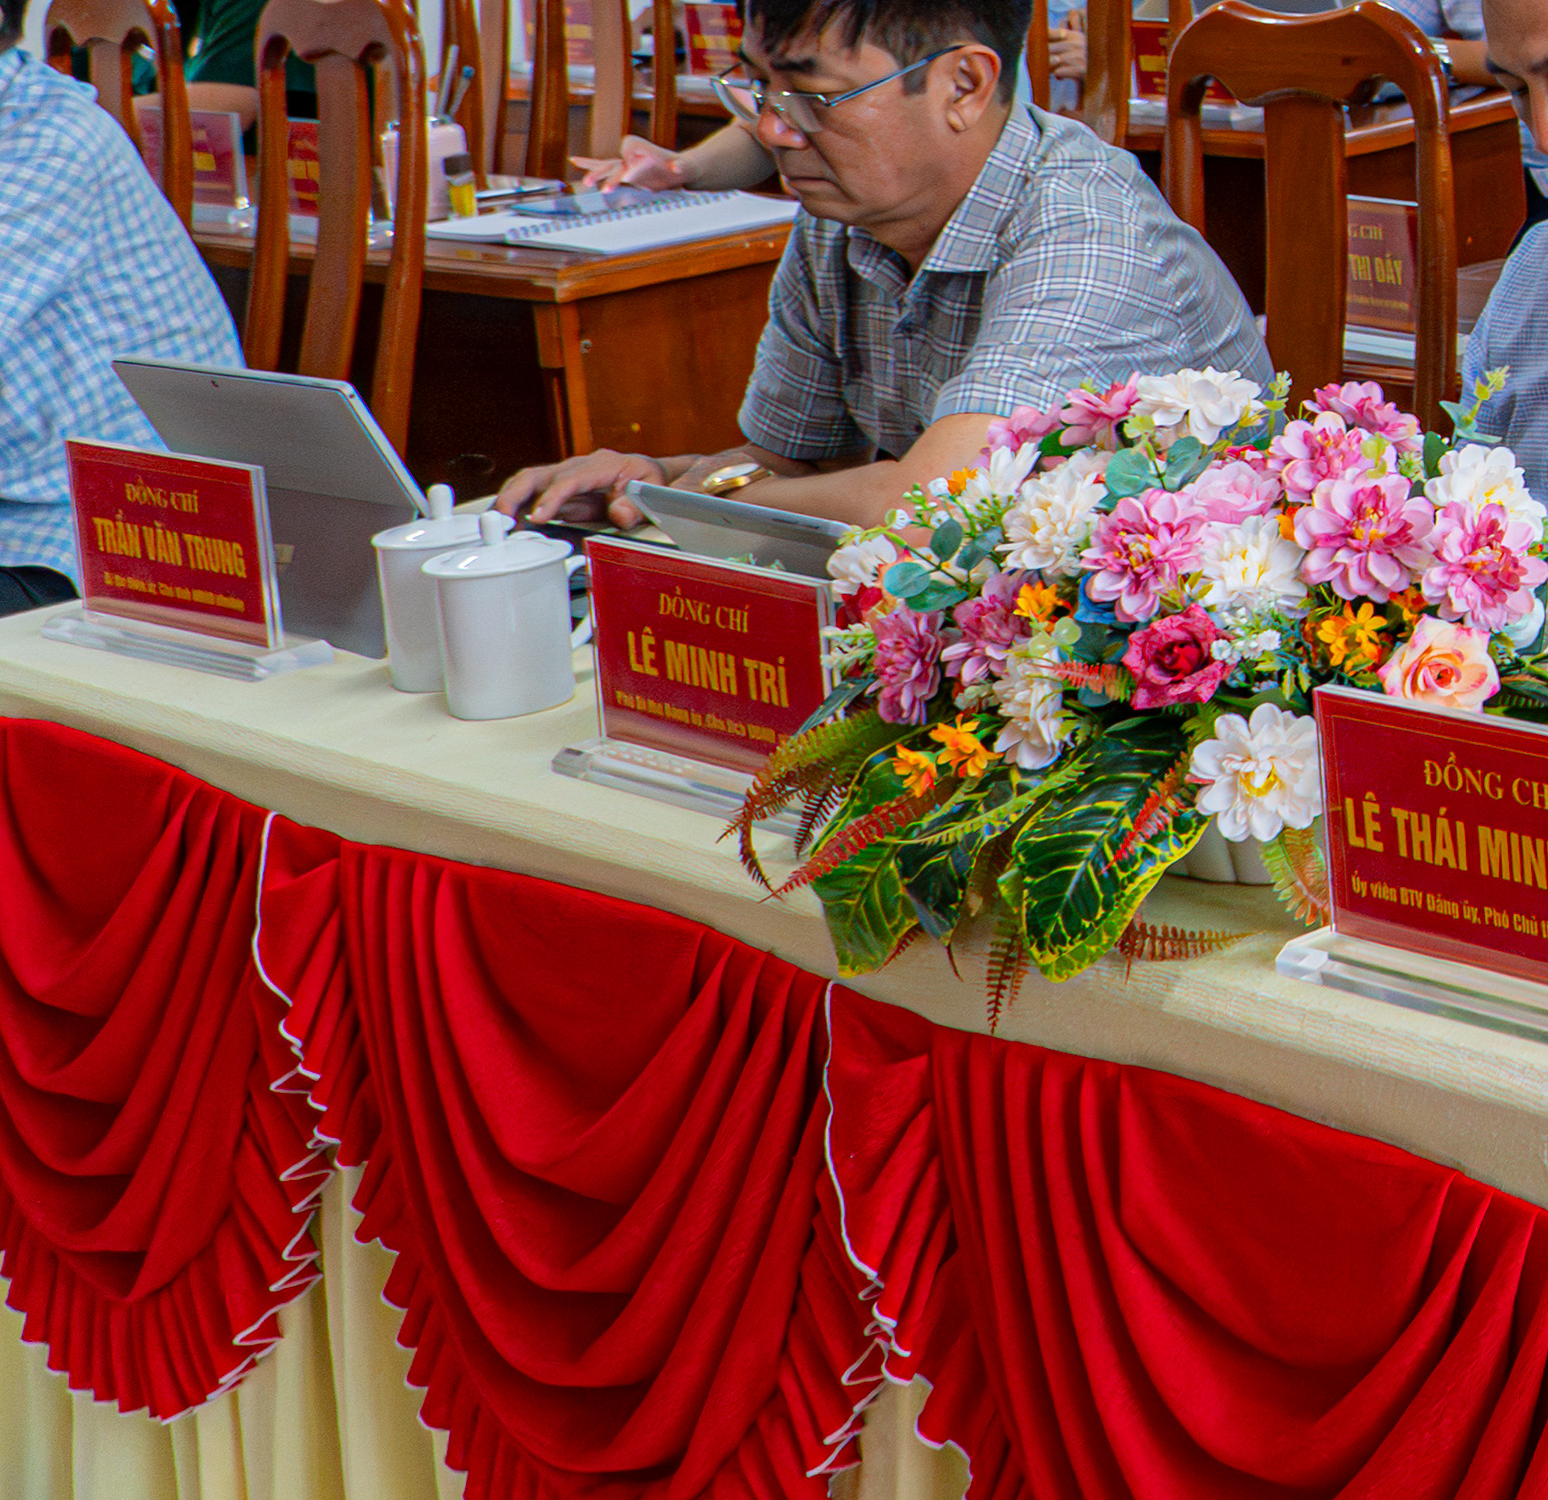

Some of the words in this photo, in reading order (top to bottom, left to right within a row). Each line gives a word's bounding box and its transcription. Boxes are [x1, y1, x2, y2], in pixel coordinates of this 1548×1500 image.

[93, 509, 142, 559] TRẦN
[142, 521, 182, 566] VĂN
[183, 533, 246, 578] TRUNG
[659, 585, 710, 624] ĐỒNG
[715, 604, 748, 633] CHÍ
[627, 626, 658, 676] LÊ
[664, 640, 737, 695] MINH
[743, 656, 788, 707] TRÍ
[1423, 752, 1503, 800] ĐỒNG
[1344, 792, 1384, 853] LÊ
[1390, 807, 1468, 871] THÁI
[1370, 881, 1397, 903] viên
[1399, 888, 1423, 909] BTV
[1483, 906, 1509, 929] Phó
[1512, 913, 1538, 936] Chủ
